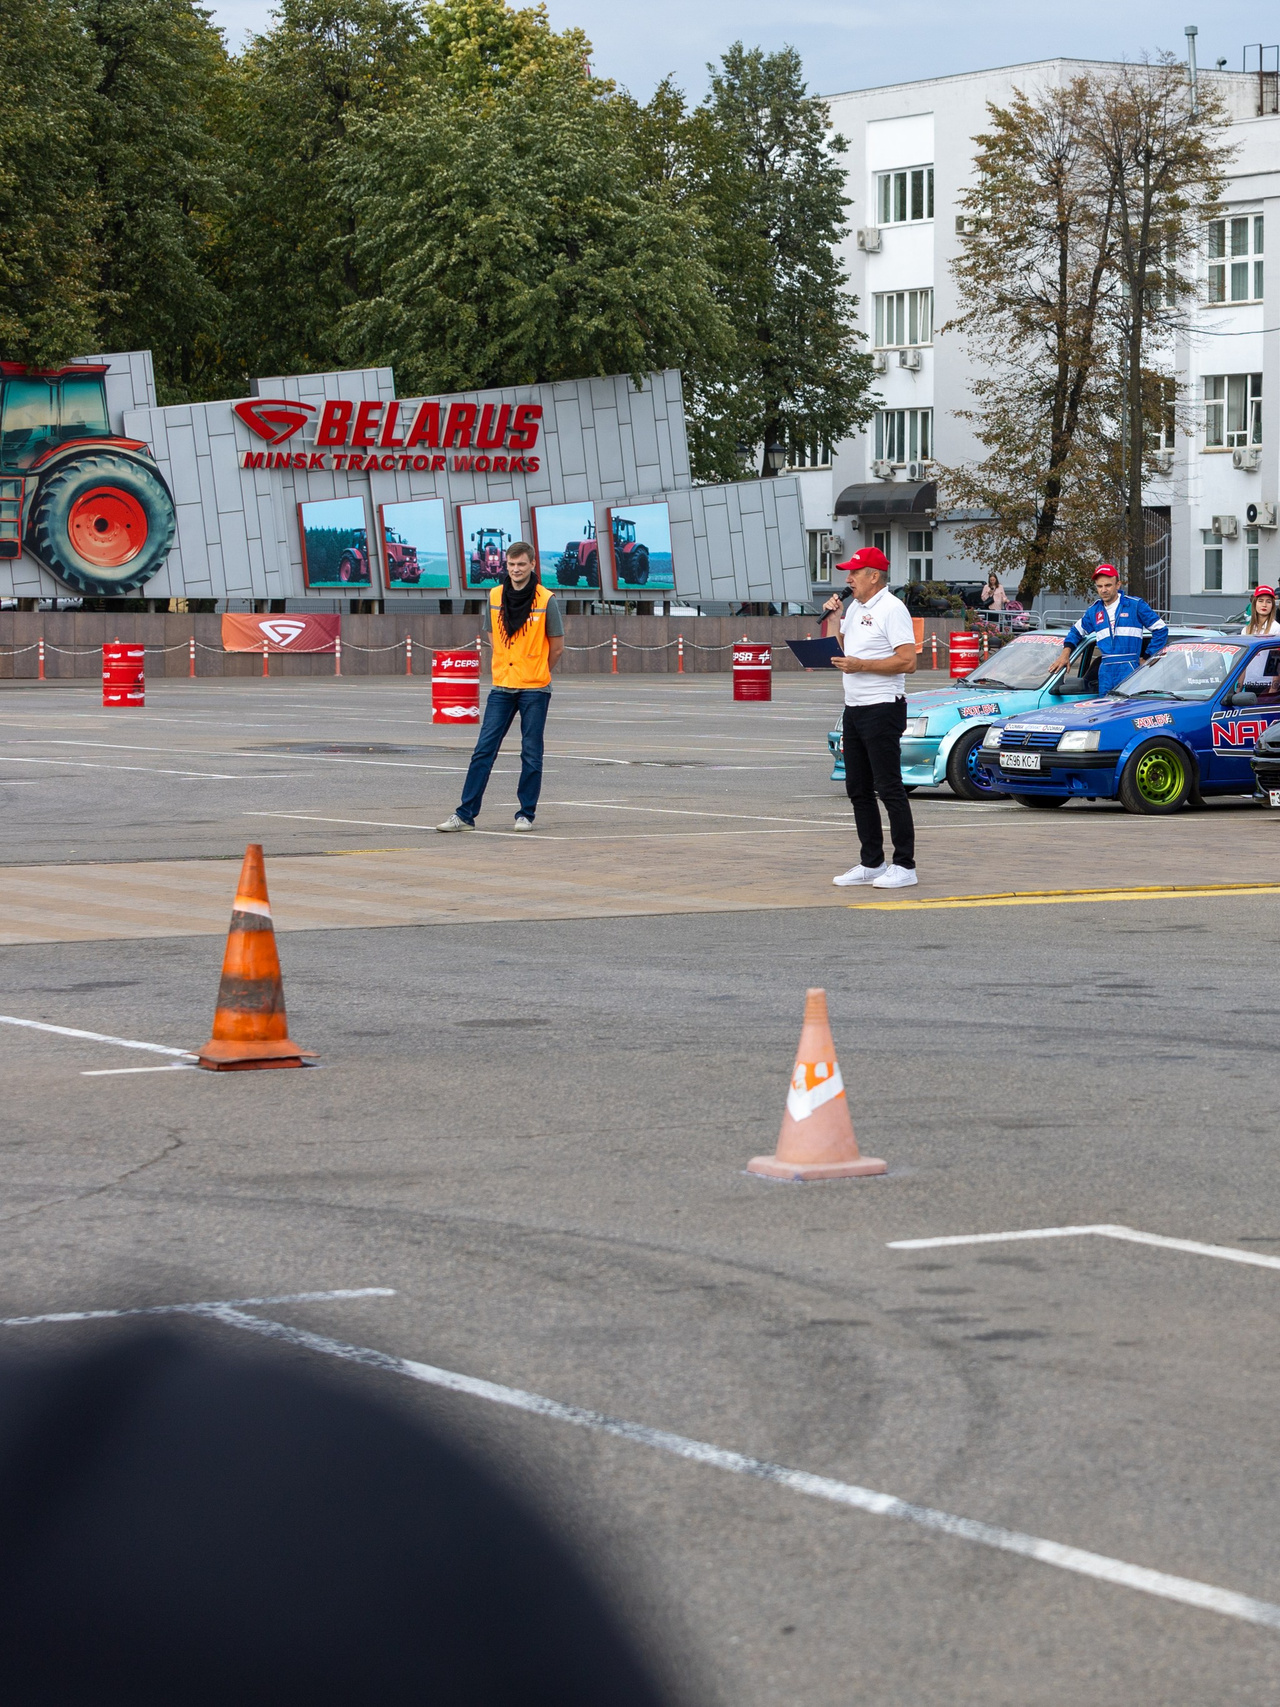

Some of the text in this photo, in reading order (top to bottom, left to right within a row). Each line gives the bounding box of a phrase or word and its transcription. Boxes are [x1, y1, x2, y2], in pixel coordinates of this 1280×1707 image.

[313, 399, 544, 450] BELARUS
[240, 451, 541, 473] MINSK TRACTOR WORKS
[1005, 754, 1039, 768] 2596 KC-7
